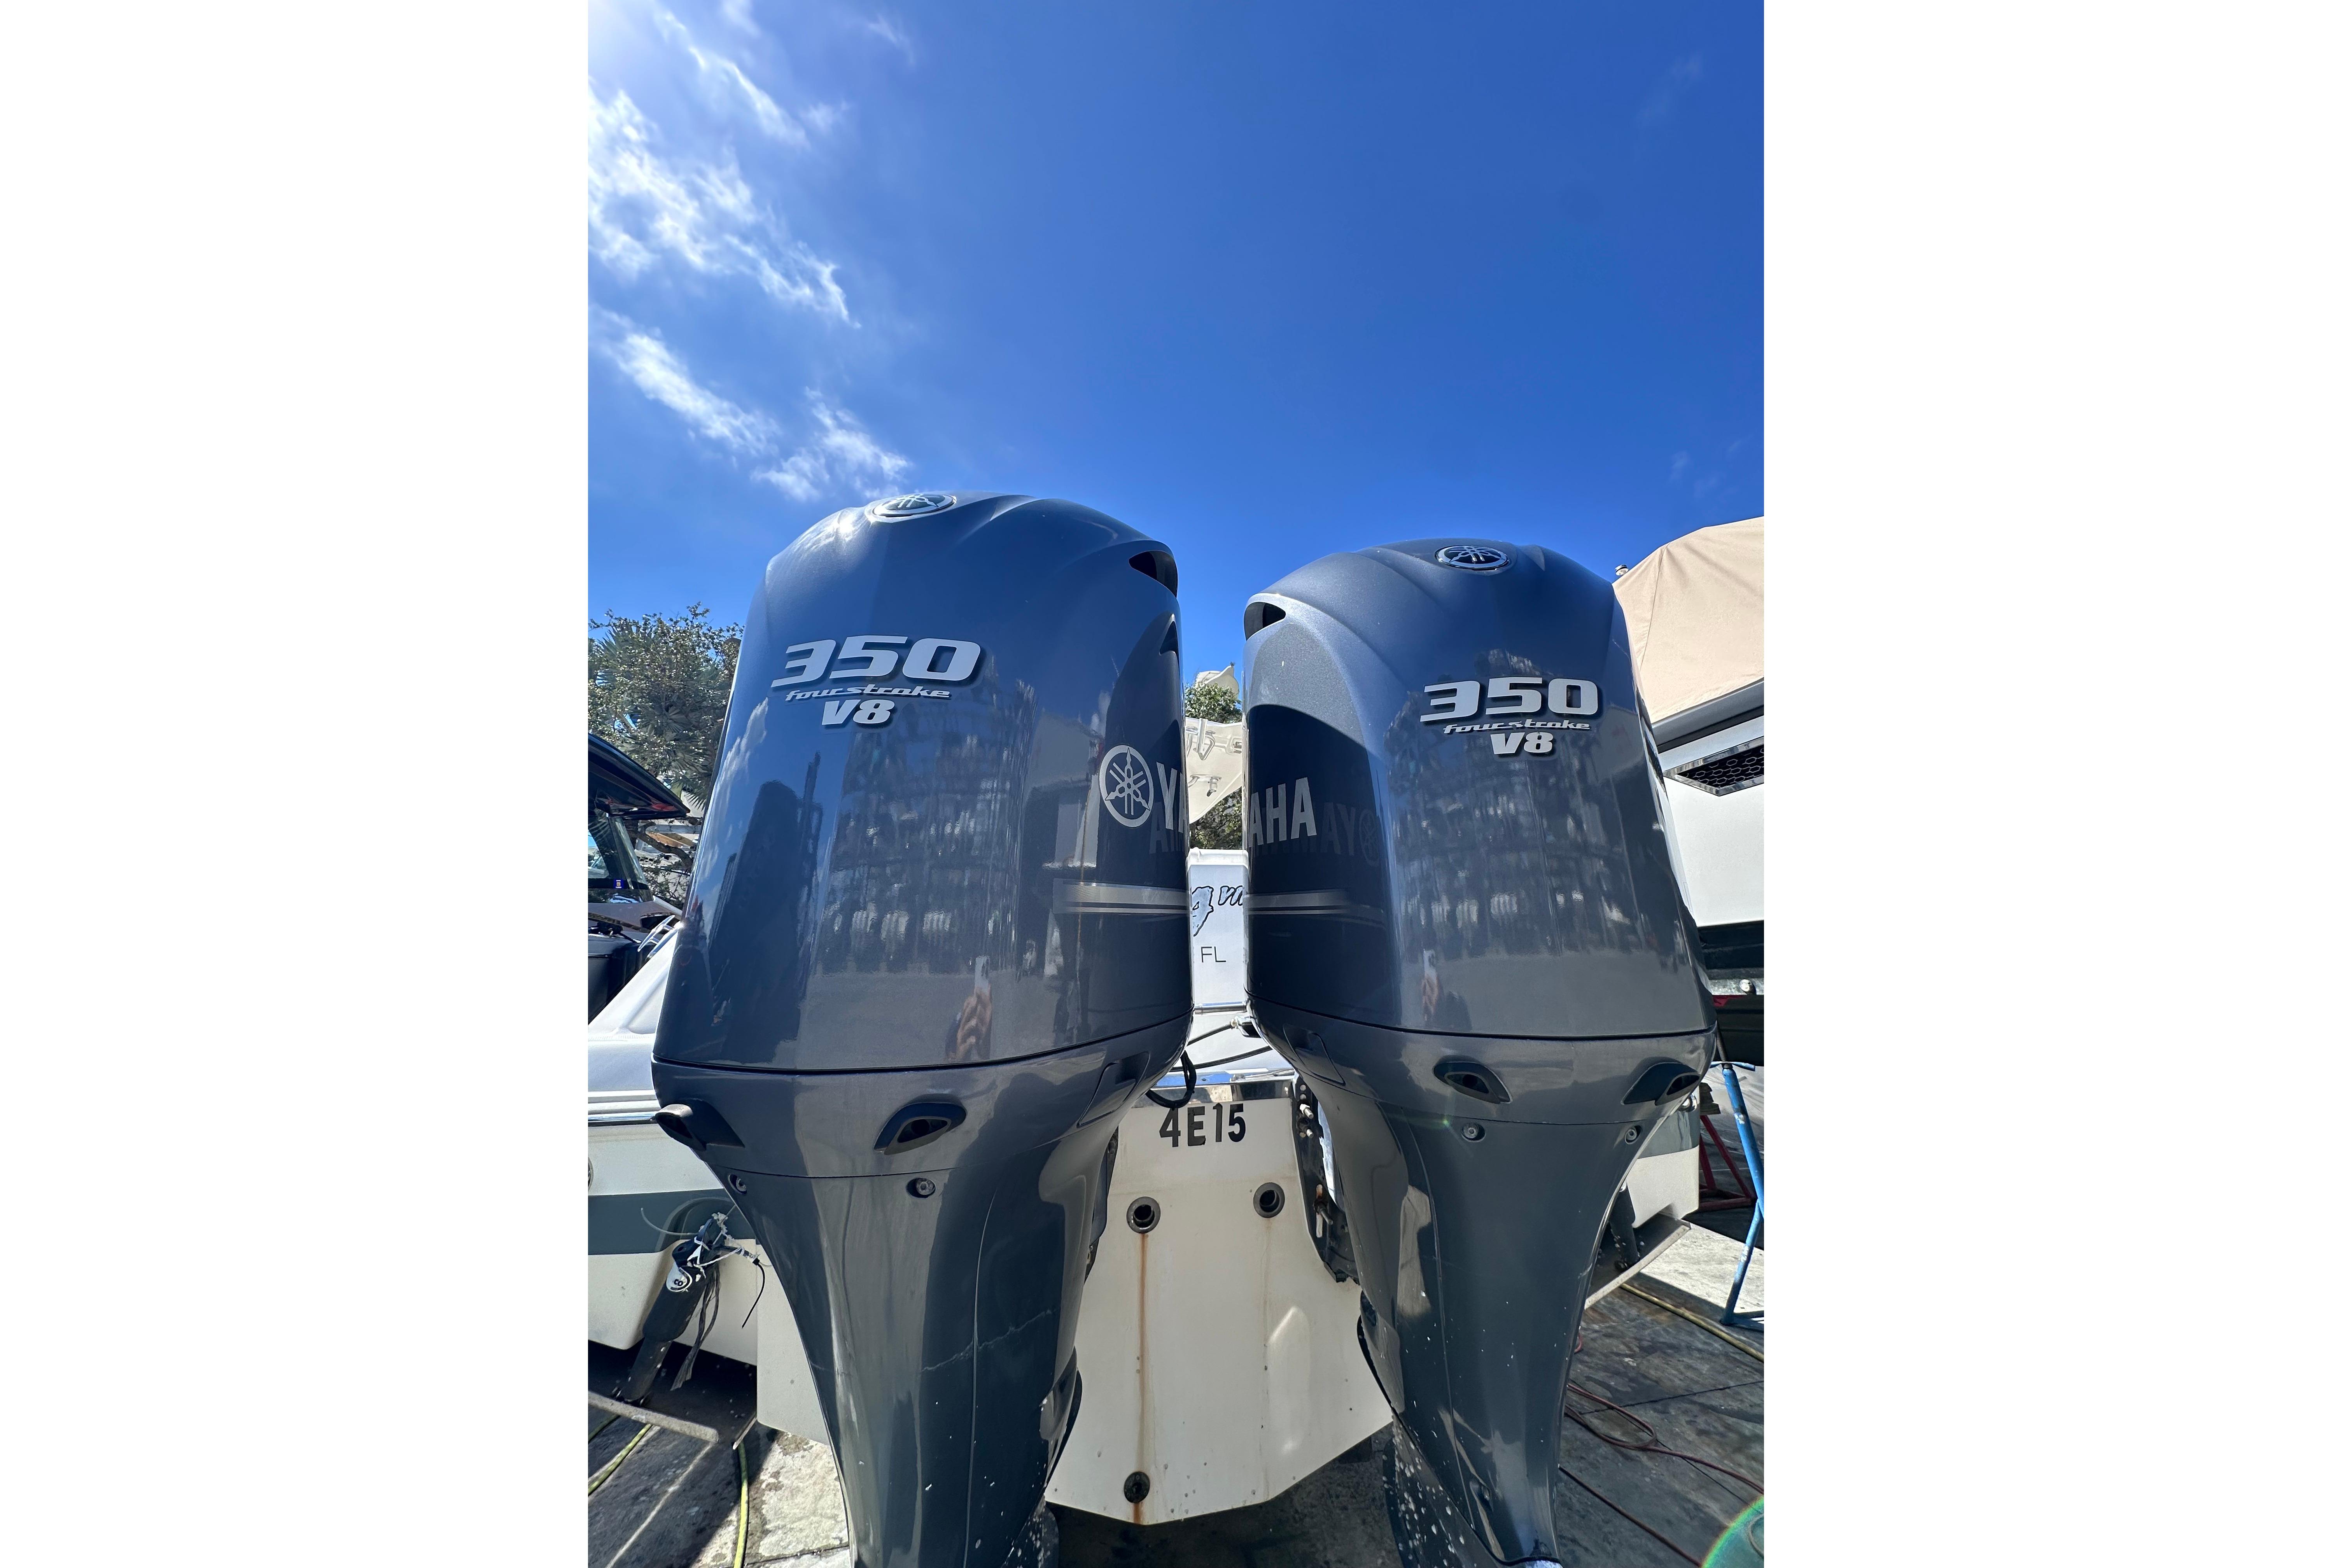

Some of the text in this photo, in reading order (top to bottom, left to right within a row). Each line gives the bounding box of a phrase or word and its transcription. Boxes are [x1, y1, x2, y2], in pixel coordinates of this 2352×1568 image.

[771, 635, 981, 688] 350
[822, 699, 895, 725] V8
[1420, 677, 1598, 722] 350
[1490, 732, 1553, 754] V8
[1200, 946, 1227, 963] FL
